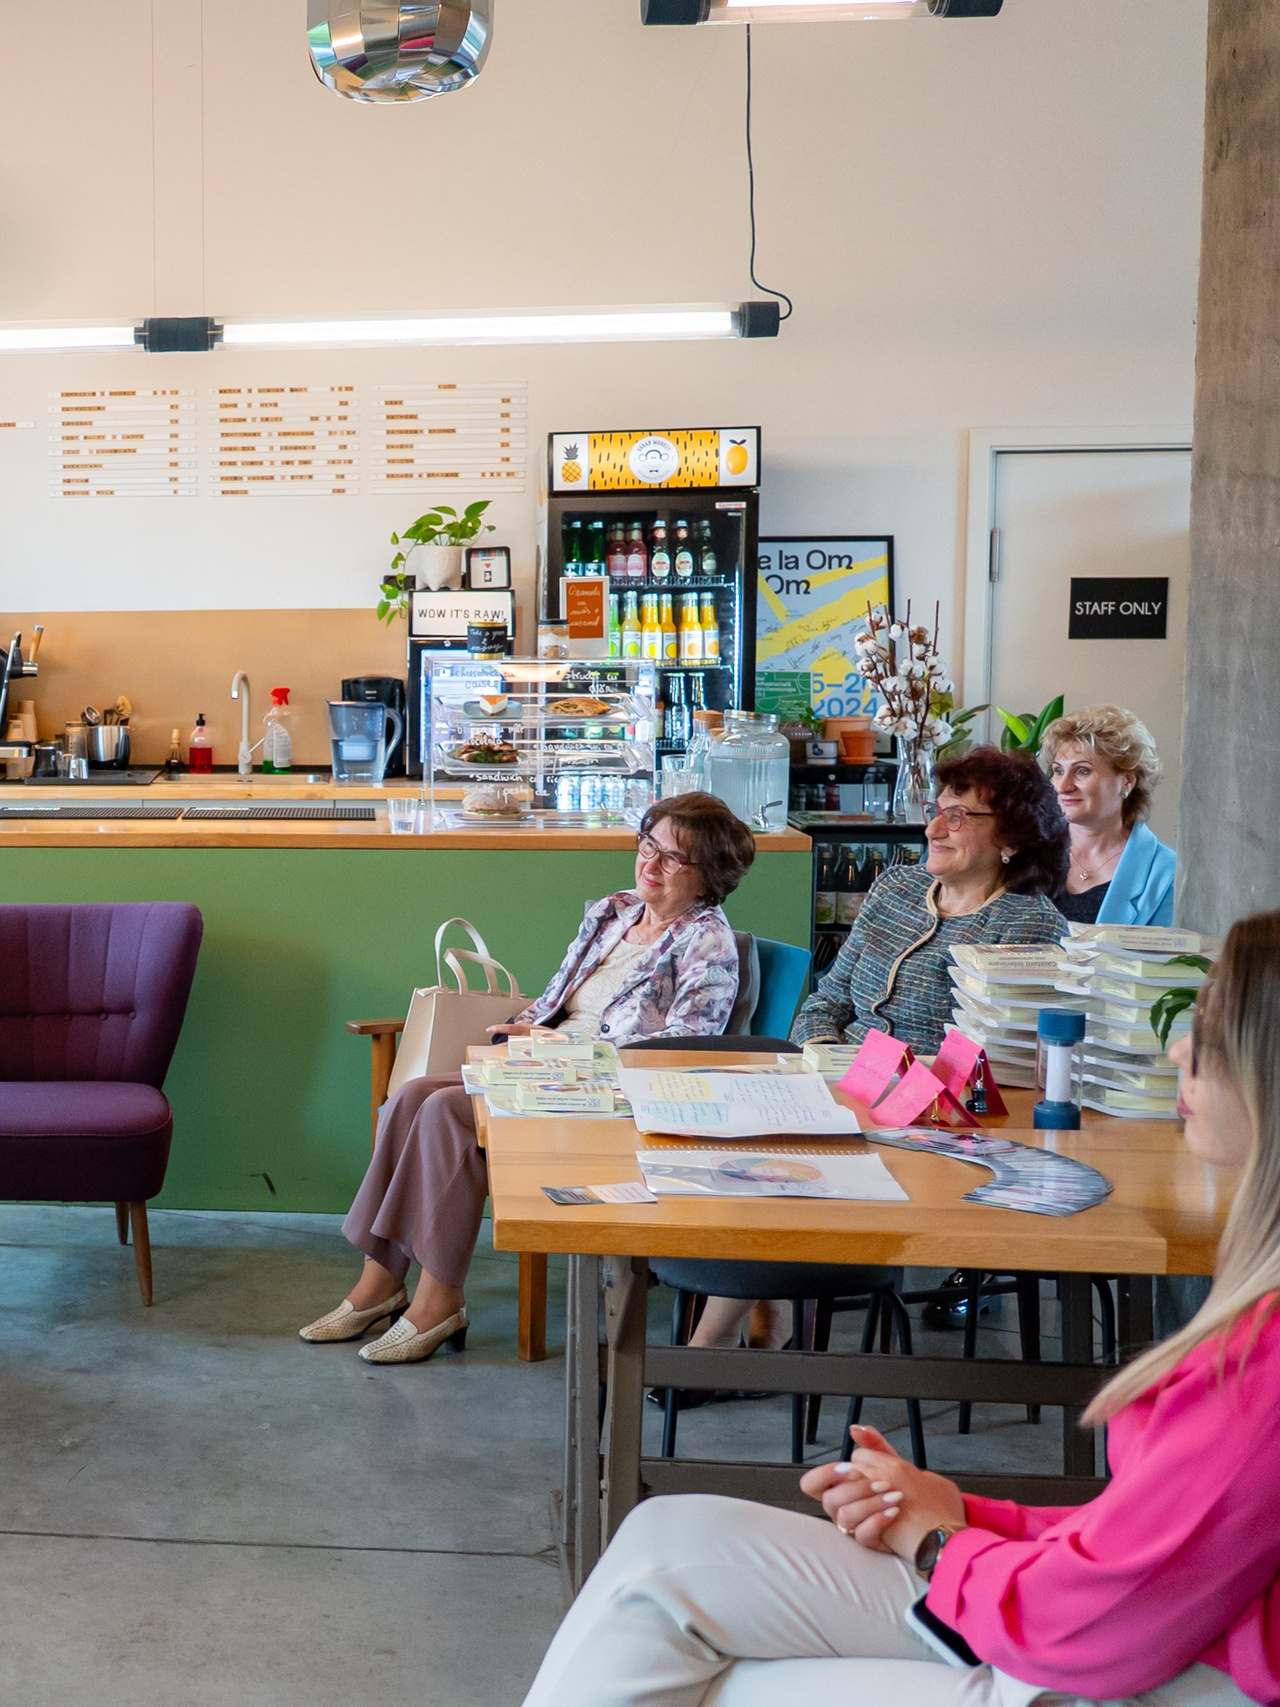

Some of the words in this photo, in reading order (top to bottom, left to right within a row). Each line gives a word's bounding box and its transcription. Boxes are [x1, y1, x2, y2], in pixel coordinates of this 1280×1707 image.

[779, 550, 799, 570] la
[806, 550, 853, 570] Om
[418, 609, 446, 619] WOW
[450, 609, 470, 619] IT'S
[474, 610, 504, 619] RAW!
[1075, 602, 1115, 615] STAFF
[1119, 602, 1161, 615] ONLY
[814, 698, 878, 718] 2024
